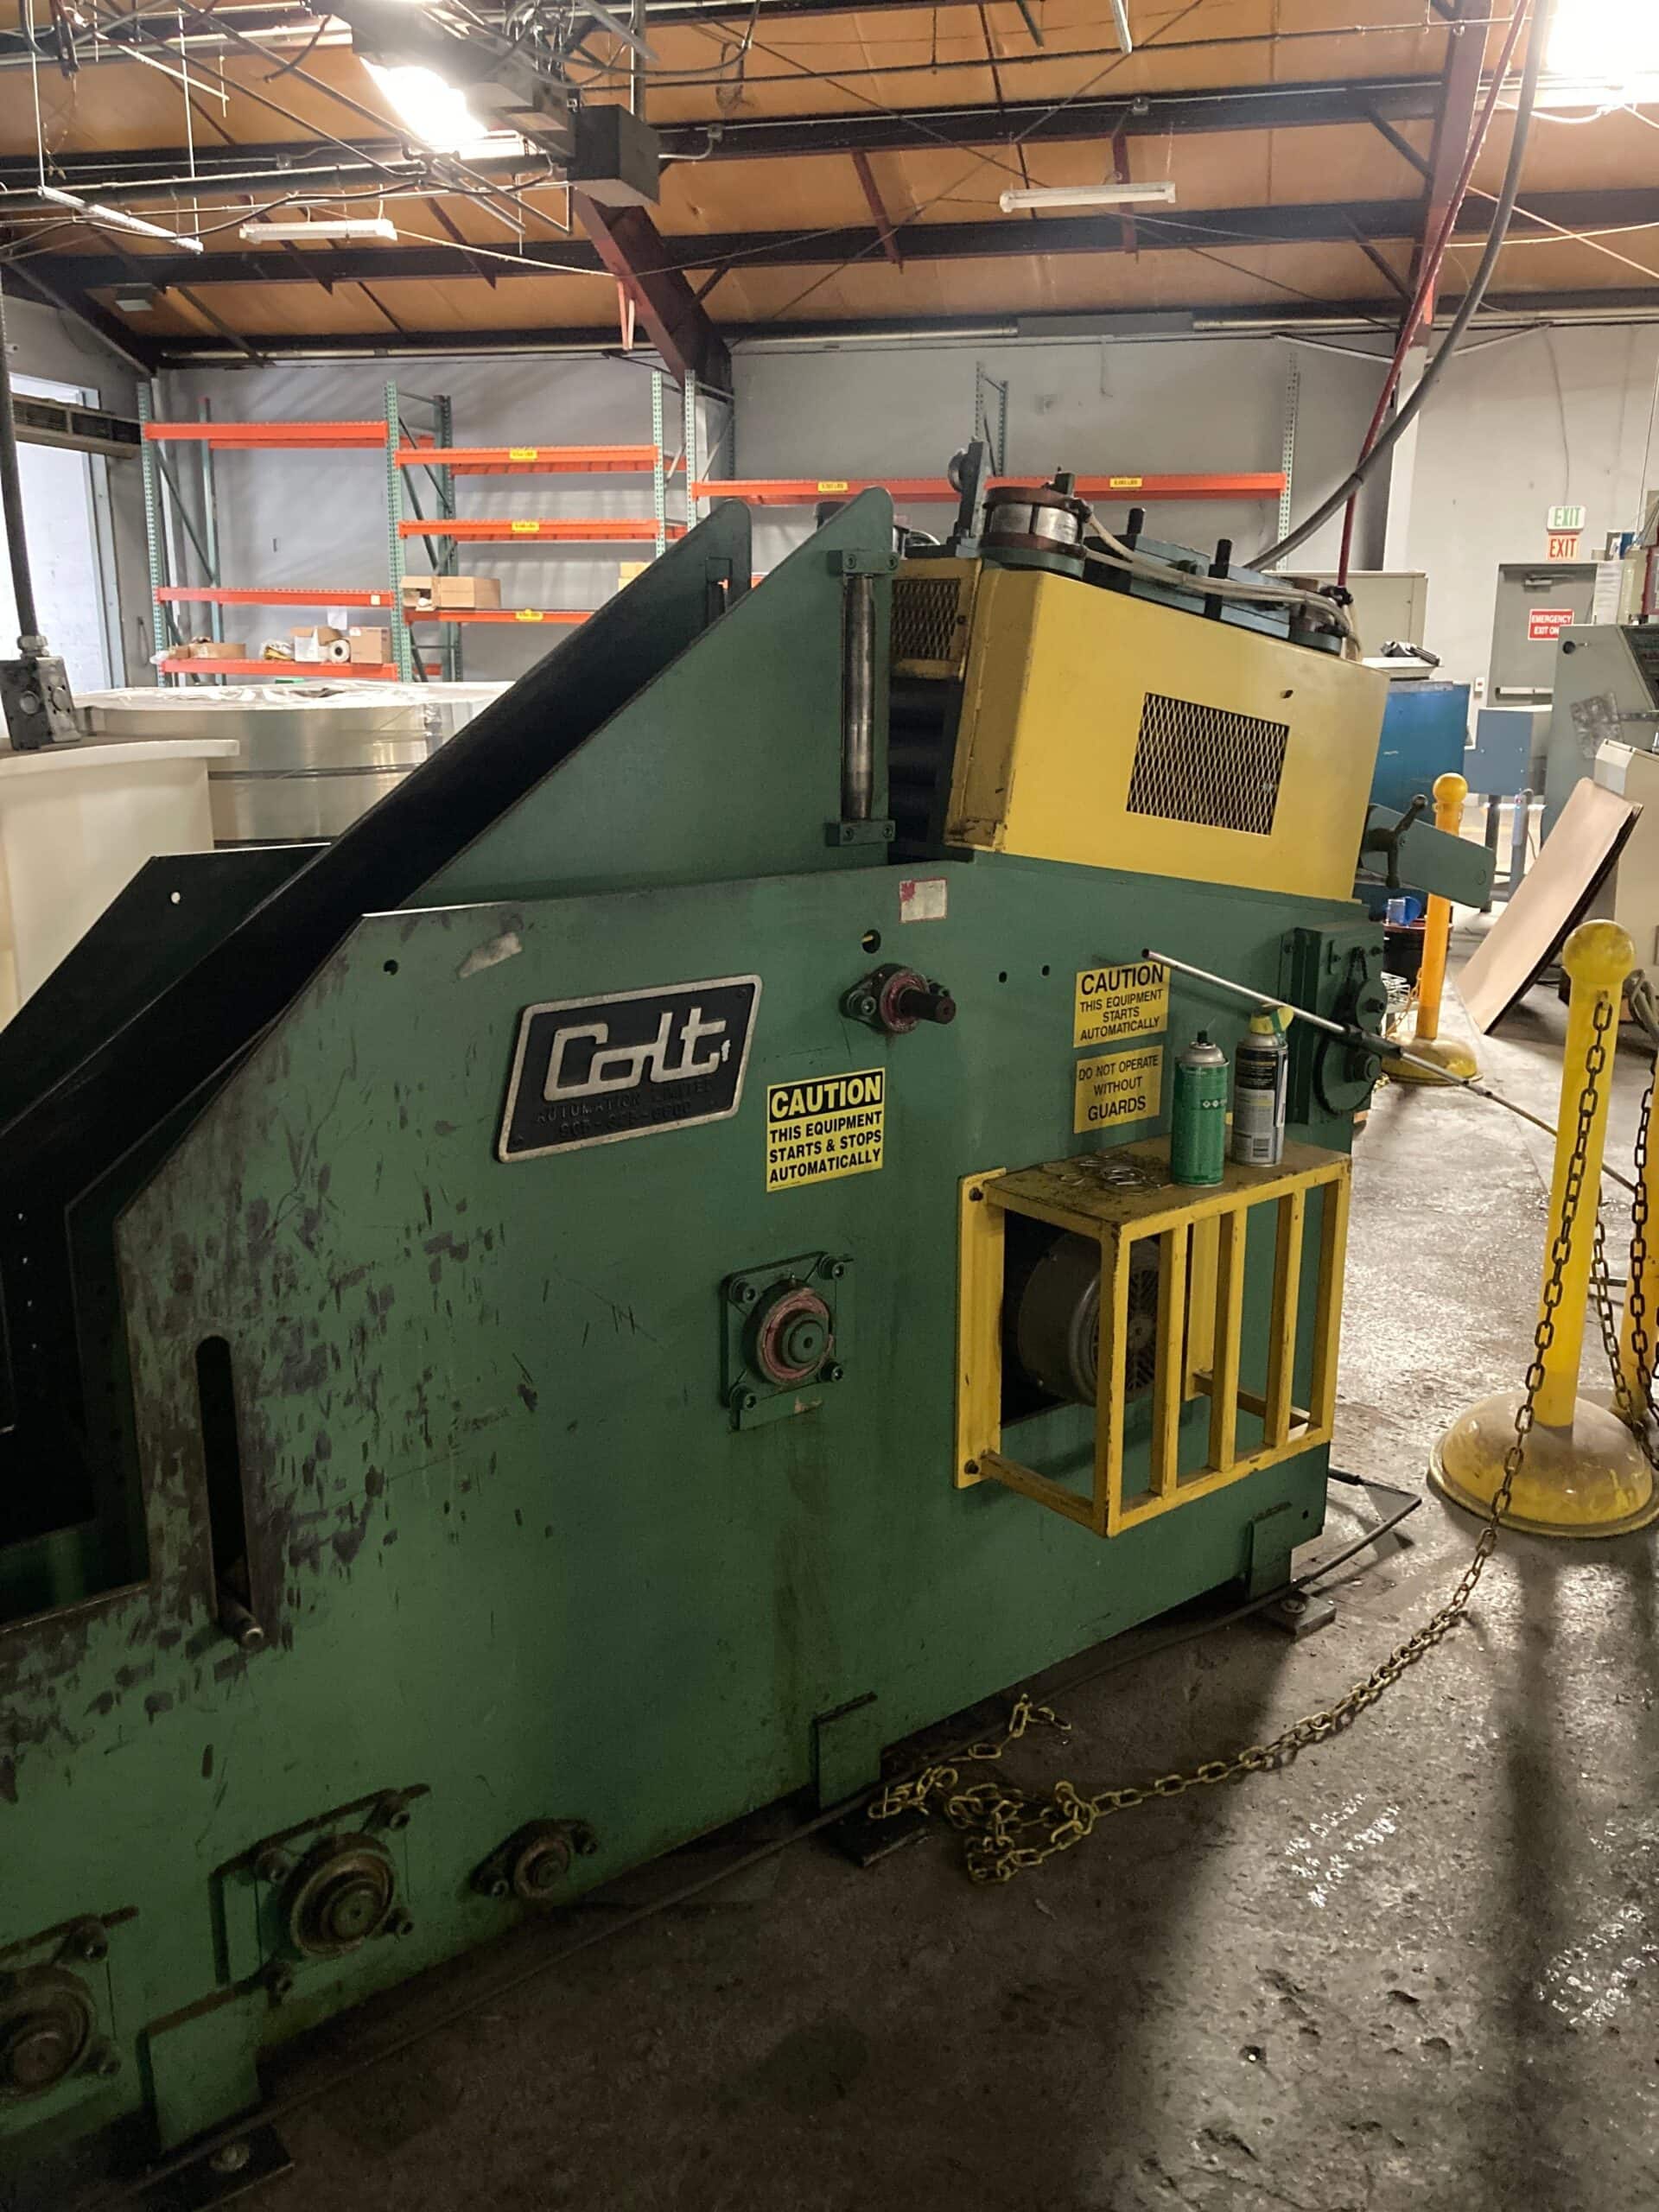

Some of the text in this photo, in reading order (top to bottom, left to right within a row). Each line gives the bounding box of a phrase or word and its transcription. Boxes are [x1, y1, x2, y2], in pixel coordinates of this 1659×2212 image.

[1554, 507, 1580, 527] EXIT
[1549, 538, 1577, 558] EXIT
[1531, 614, 1572, 623] EMERGENCY
[1534, 626, 1560, 635] EXIT ON
[1081, 964, 1164, 995] CAUTION
[1079, 988, 1163, 1013] THIS EQUIPMENT
[1103, 1007, 1141, 1022] STARTS
[1079, 1016, 1160, 1041] AUTOMATICALLY
[543, 1007, 727, 1102] Colt
[1078, 1054, 1160, 1081] DO NOT OPERATE
[771, 1075, 881, 1119] CAUTION
[1093, 1076, 1142, 1096] WITHOUT
[1088, 1096, 1147, 1122] GUARDS
[770, 1110, 882, 1143] THIS EQUIPMENT
[770, 1129, 881, 1164] STARTS & STOPS
[770, 1147, 881, 1184] AUTOMATICALLY
